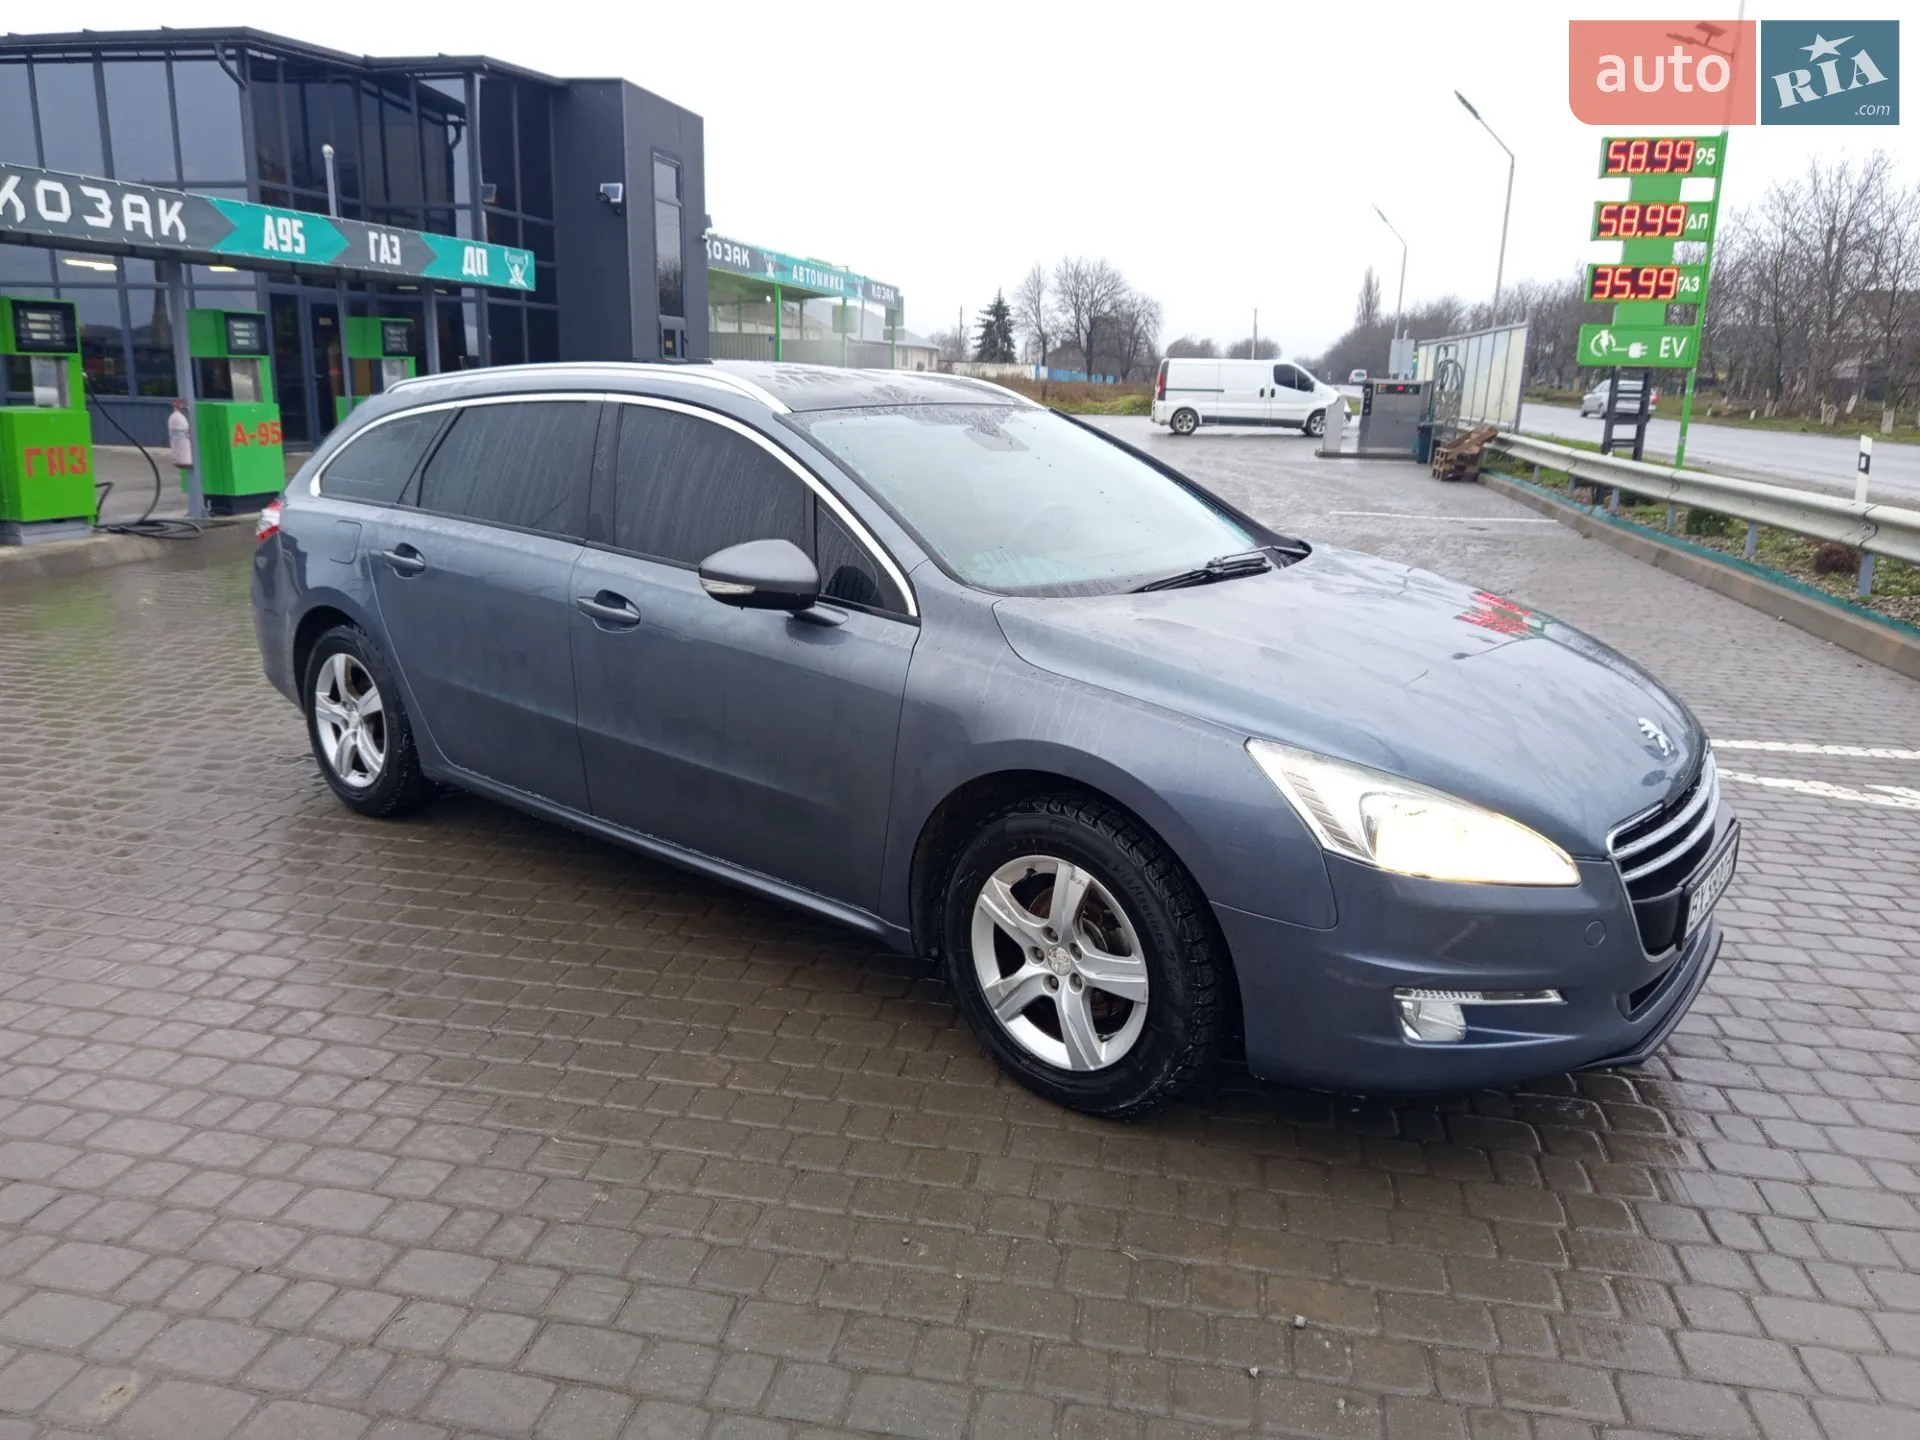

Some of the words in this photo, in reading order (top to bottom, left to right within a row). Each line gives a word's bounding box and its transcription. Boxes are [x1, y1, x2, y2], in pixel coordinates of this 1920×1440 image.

[1607, 139, 1696, 174] 58.99
[1695, 147, 1716, 166] 95
[263, 214, 306, 255] А95
[1598, 203, 1686, 238] 58.99
[368, 231, 402, 265] ГАЗ
[462, 245, 489, 278] ДП
[871, 283, 896, 304] КОЗАК
[1592, 266, 1680, 300] 35.99
[1659, 336, 1688, 358] EV
[24, 445, 87, 478] ГАЗ
